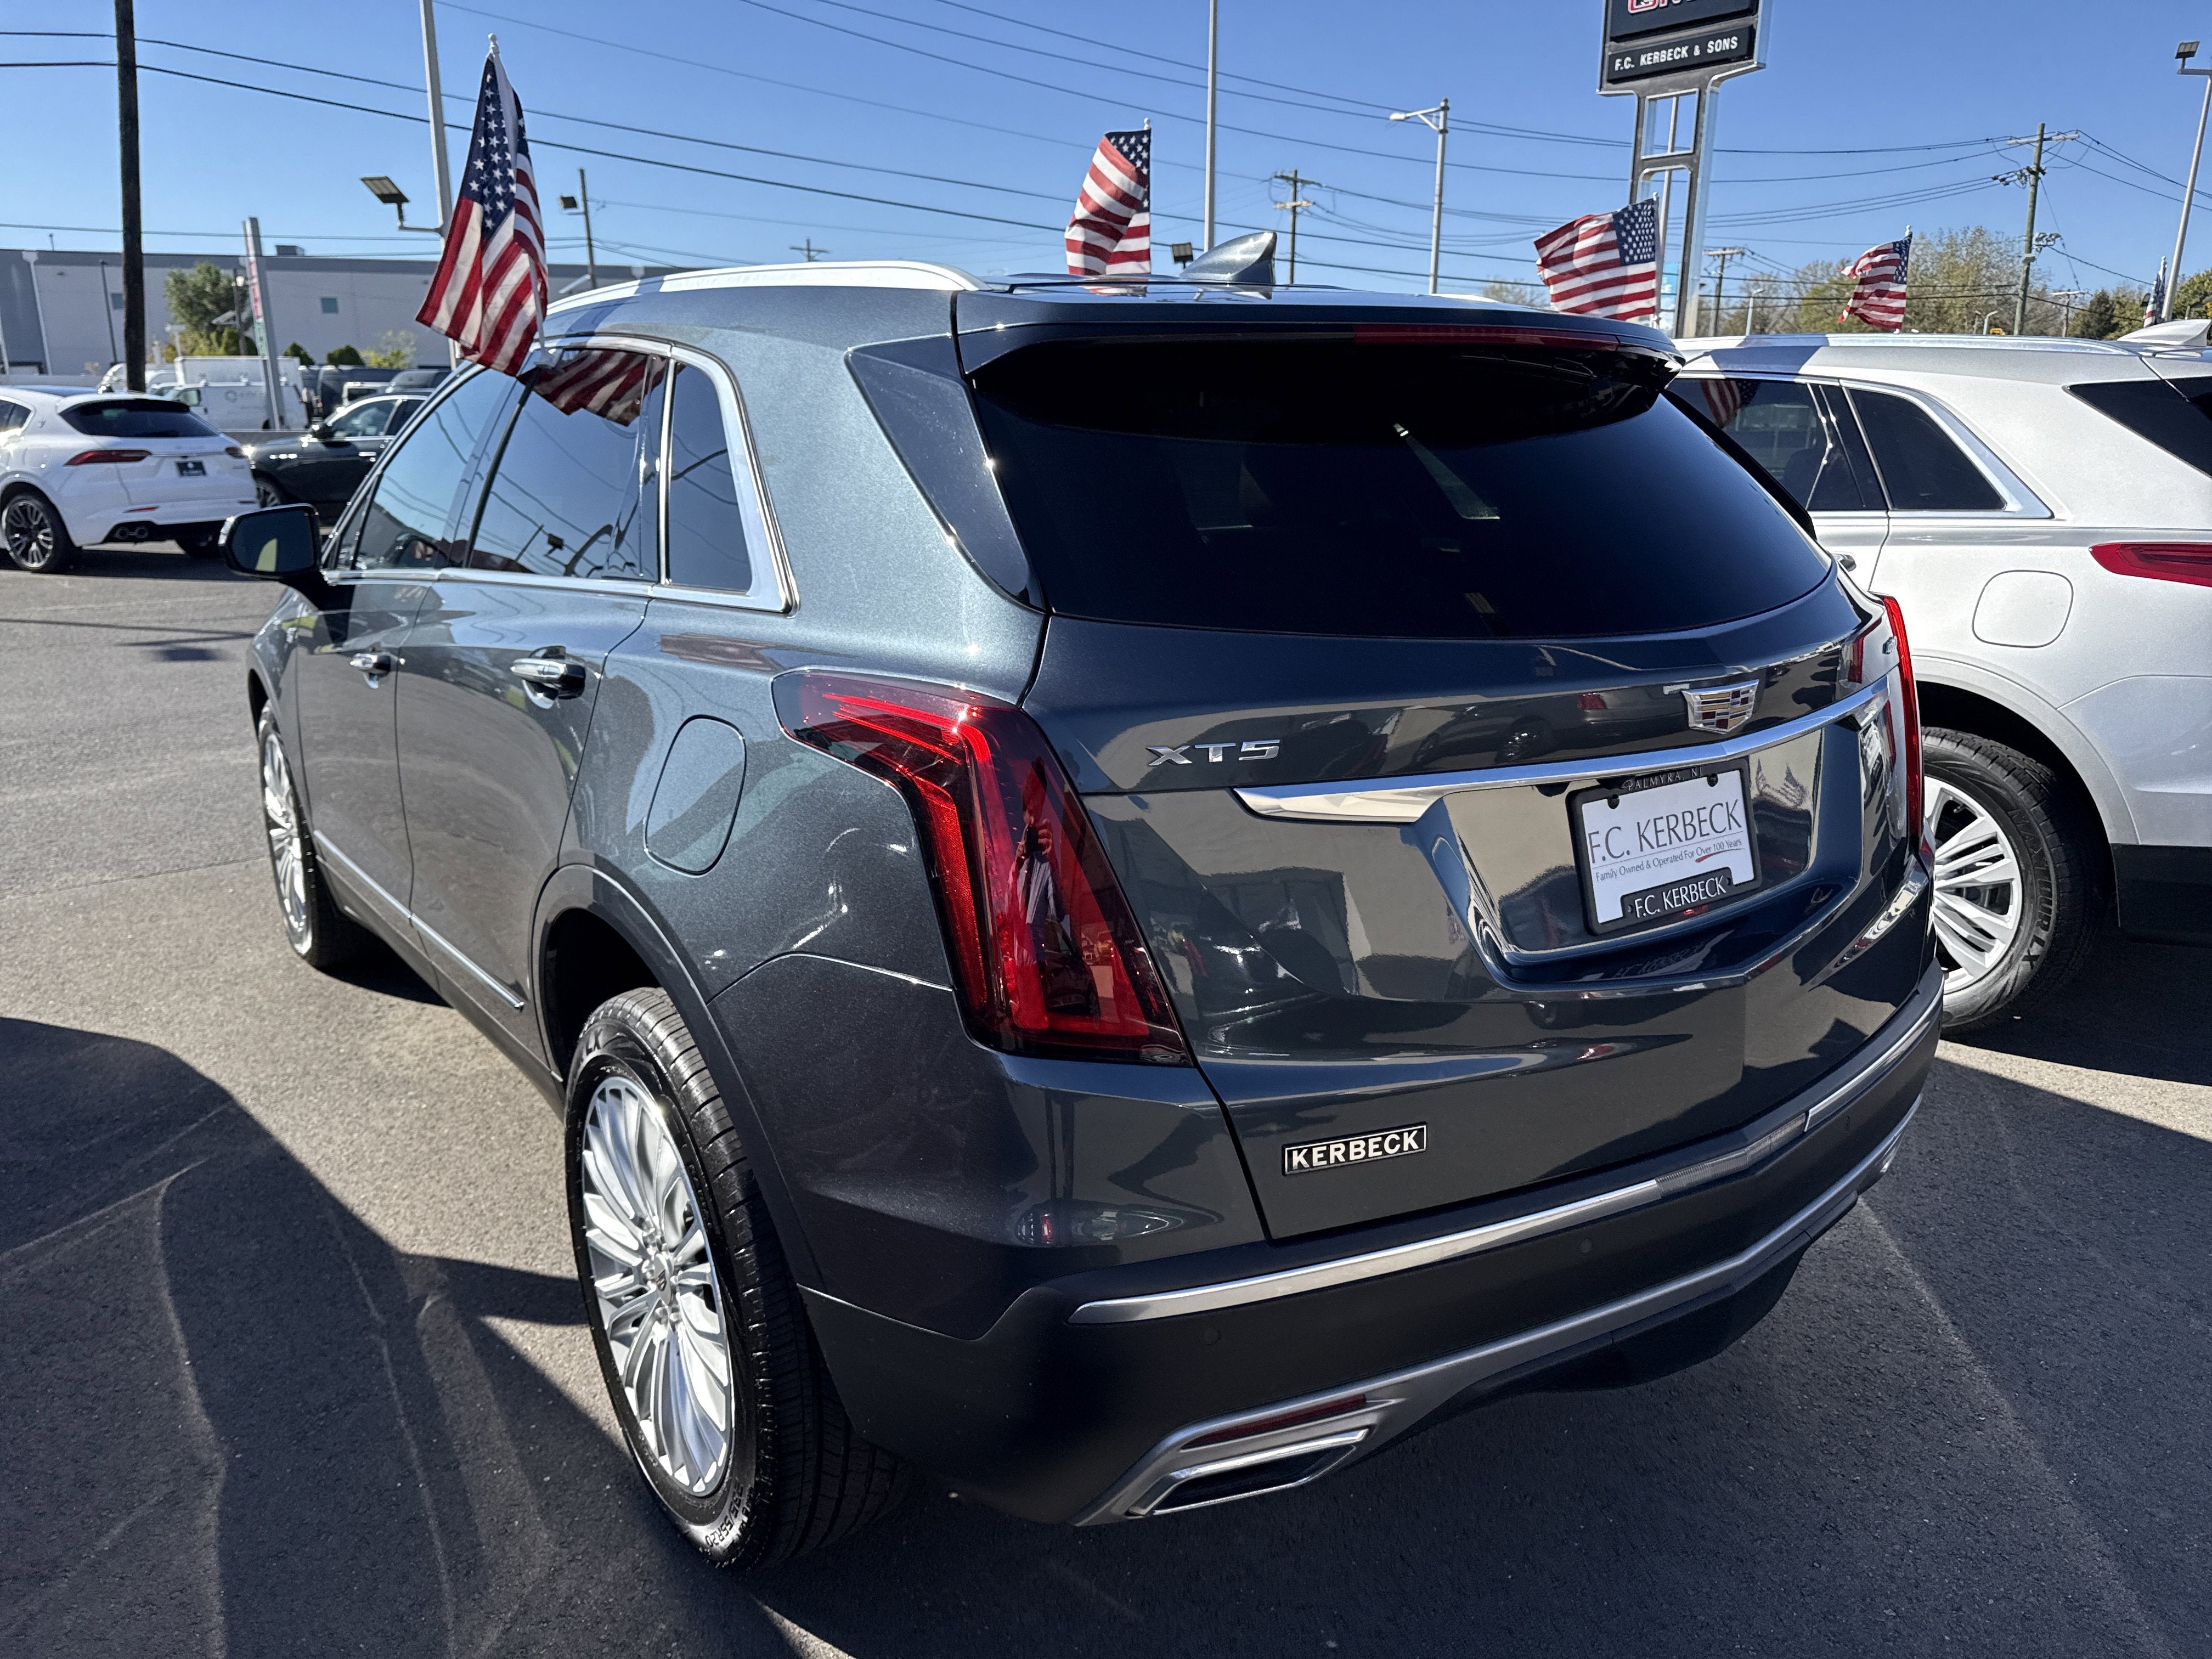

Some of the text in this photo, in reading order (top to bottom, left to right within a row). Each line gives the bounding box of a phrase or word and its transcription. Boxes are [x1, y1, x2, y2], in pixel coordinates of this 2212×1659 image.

[1615, 36, 1739, 71] F.C. KERBECK & SONS
[1146, 739, 1280, 766] XT5
[1622, 771, 1685, 791] PALMYRA,
[1588, 799, 1742, 864] F.C. KERBECK
[1595, 838, 1742, 882] Family Owned & Operated For Over 100 Years
[1634, 874, 1727, 918] F.C. KERBECK
[2022, 934, 2045, 970] LX
[1292, 1130, 1419, 1171] KERBECK
